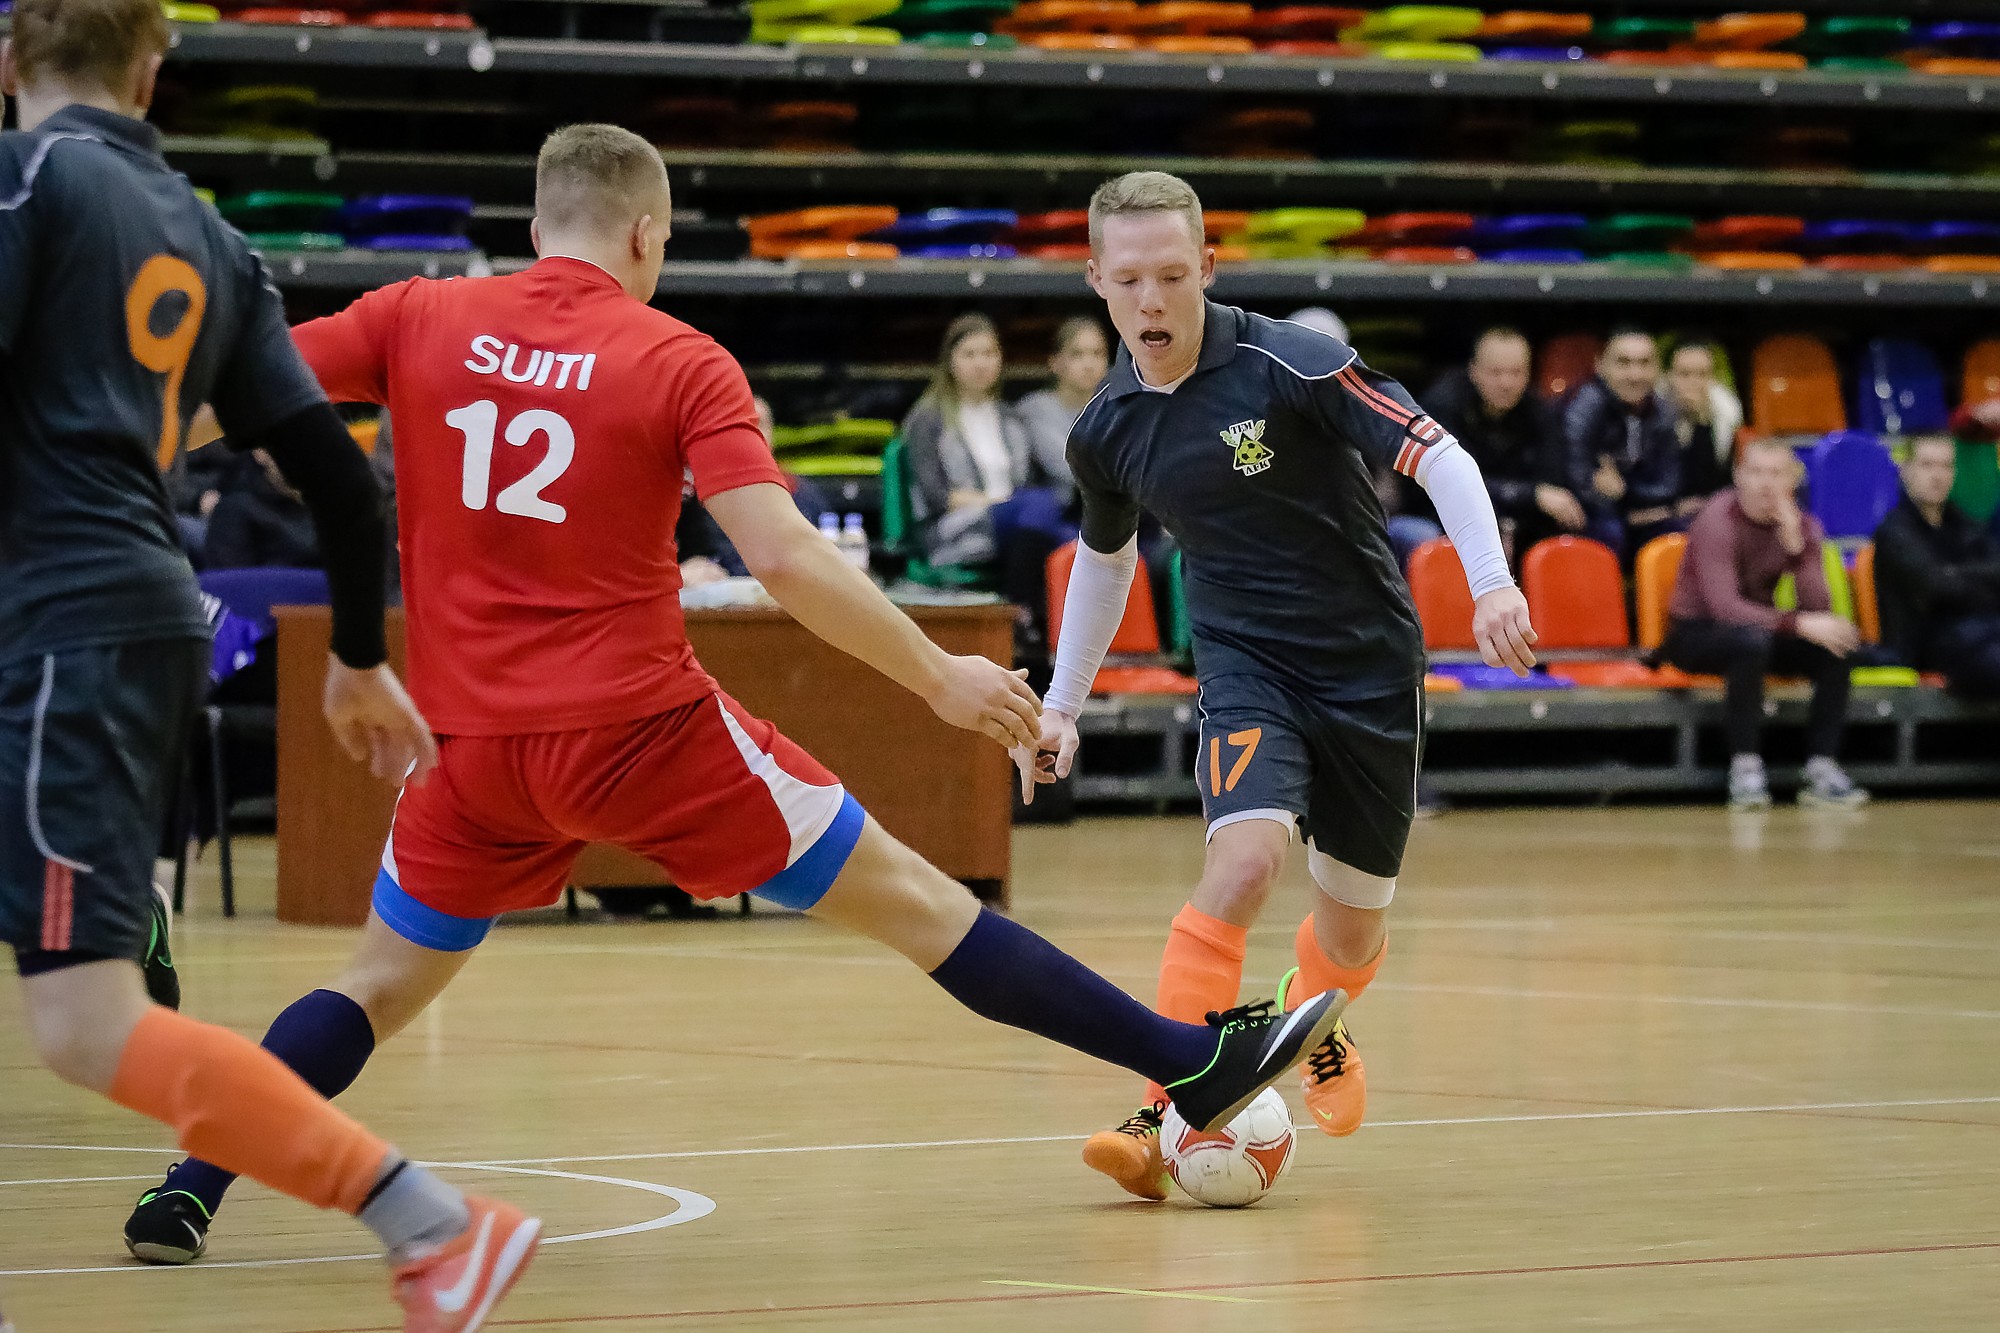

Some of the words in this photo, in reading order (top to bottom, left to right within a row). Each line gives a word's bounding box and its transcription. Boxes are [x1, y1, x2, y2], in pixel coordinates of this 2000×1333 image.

[125, 255, 207, 472] 9
[464, 334, 597, 391] SUITI
[445, 399, 576, 524] 12
[1210, 727, 1262, 798] 17
